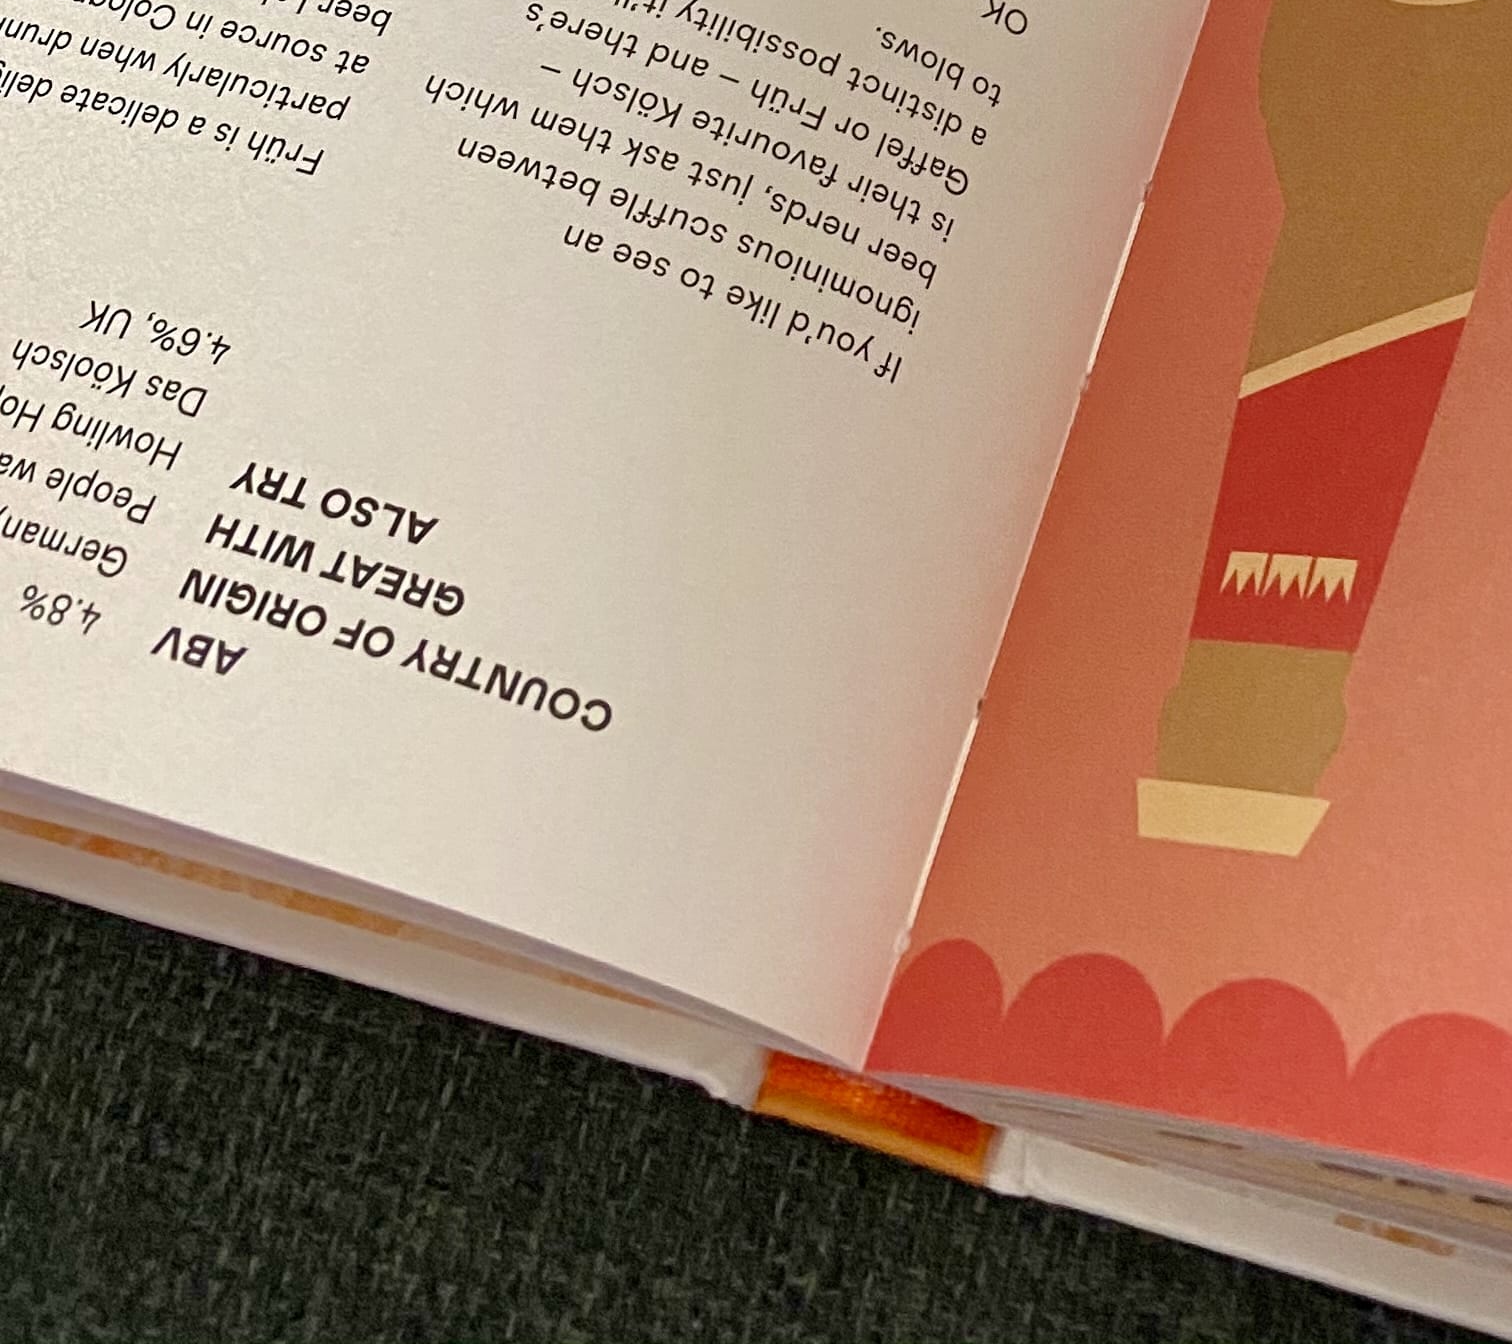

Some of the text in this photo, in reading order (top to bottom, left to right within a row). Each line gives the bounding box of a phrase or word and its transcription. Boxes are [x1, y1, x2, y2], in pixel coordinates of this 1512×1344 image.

[0, 15, 353, 122] particularly when drun
[218, 19, 329, 64] source
[874, 25, 966, 92] blows.
[59, 83, 181, 136] delicate
[524, 1, 970, 197] Gaffel Früh and there’s
[845, 65, 964, 138] distinct
[246, 129, 326, 177] Früh
[424, 73, 939, 291] beer nerds, just ask them which
[571, 67, 922, 226] their favourite Kölsch
[456, 136, 922, 337] ignominious scuffle between
[77, 299, 233, 367] 4.6%, UK
[611, 242, 876, 364] you’d like see
[11, 337, 210, 419] Das Köolsch
[0, 383, 185, 473] Howling Ho
[44, 466, 159, 526] People
[227, 460, 441, 546] ALSO TRY
[0, 504, 129, 579] German
[203, 512, 466, 618] GREAT WITH
[18, 583, 103, 637] 4.8%
[148, 625, 250, 677] ABV
[177, 567, 614, 733] COUNTRY OF ORIGIN
